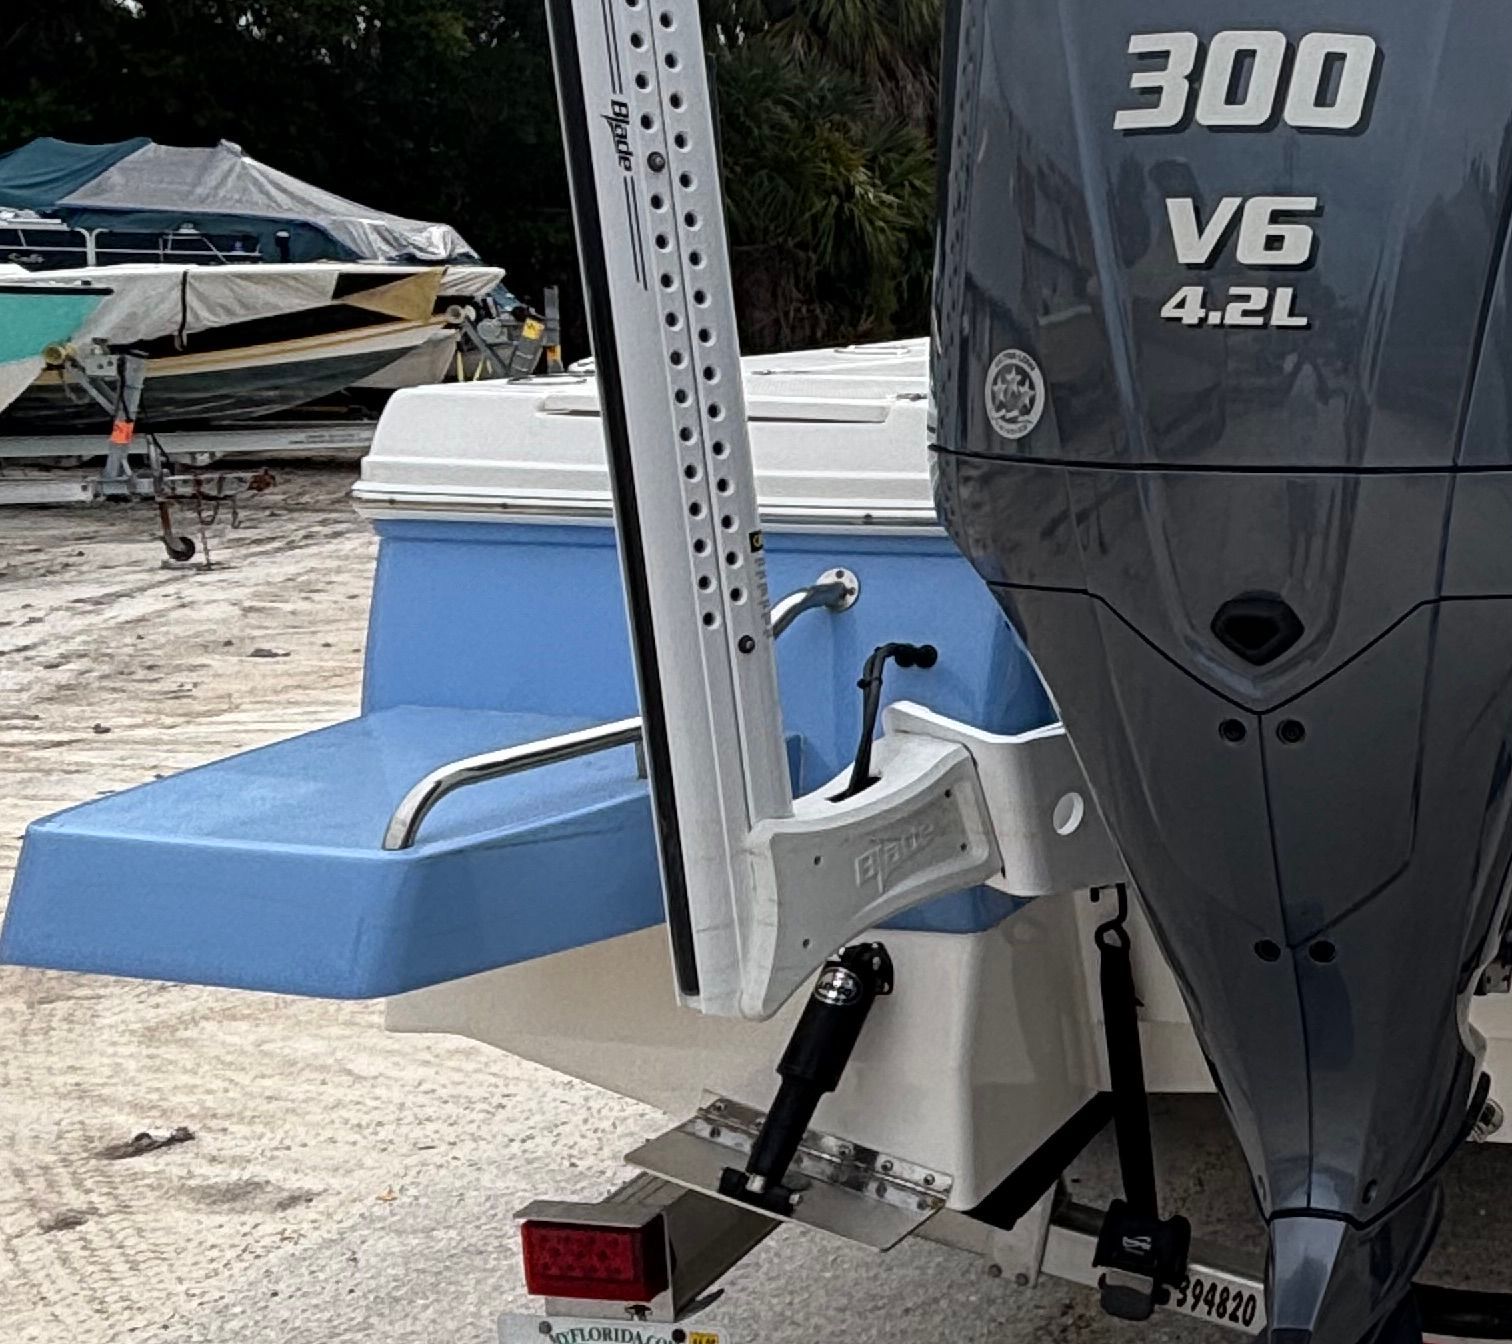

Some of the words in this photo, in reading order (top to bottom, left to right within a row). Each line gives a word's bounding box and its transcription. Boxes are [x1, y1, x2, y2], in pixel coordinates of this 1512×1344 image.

[1113, 30, 1384, 138] 300
[600, 99, 634, 172] Blade
[1165, 196, 1324, 272] V6
[1160, 286, 1312, 330] 4.2L
